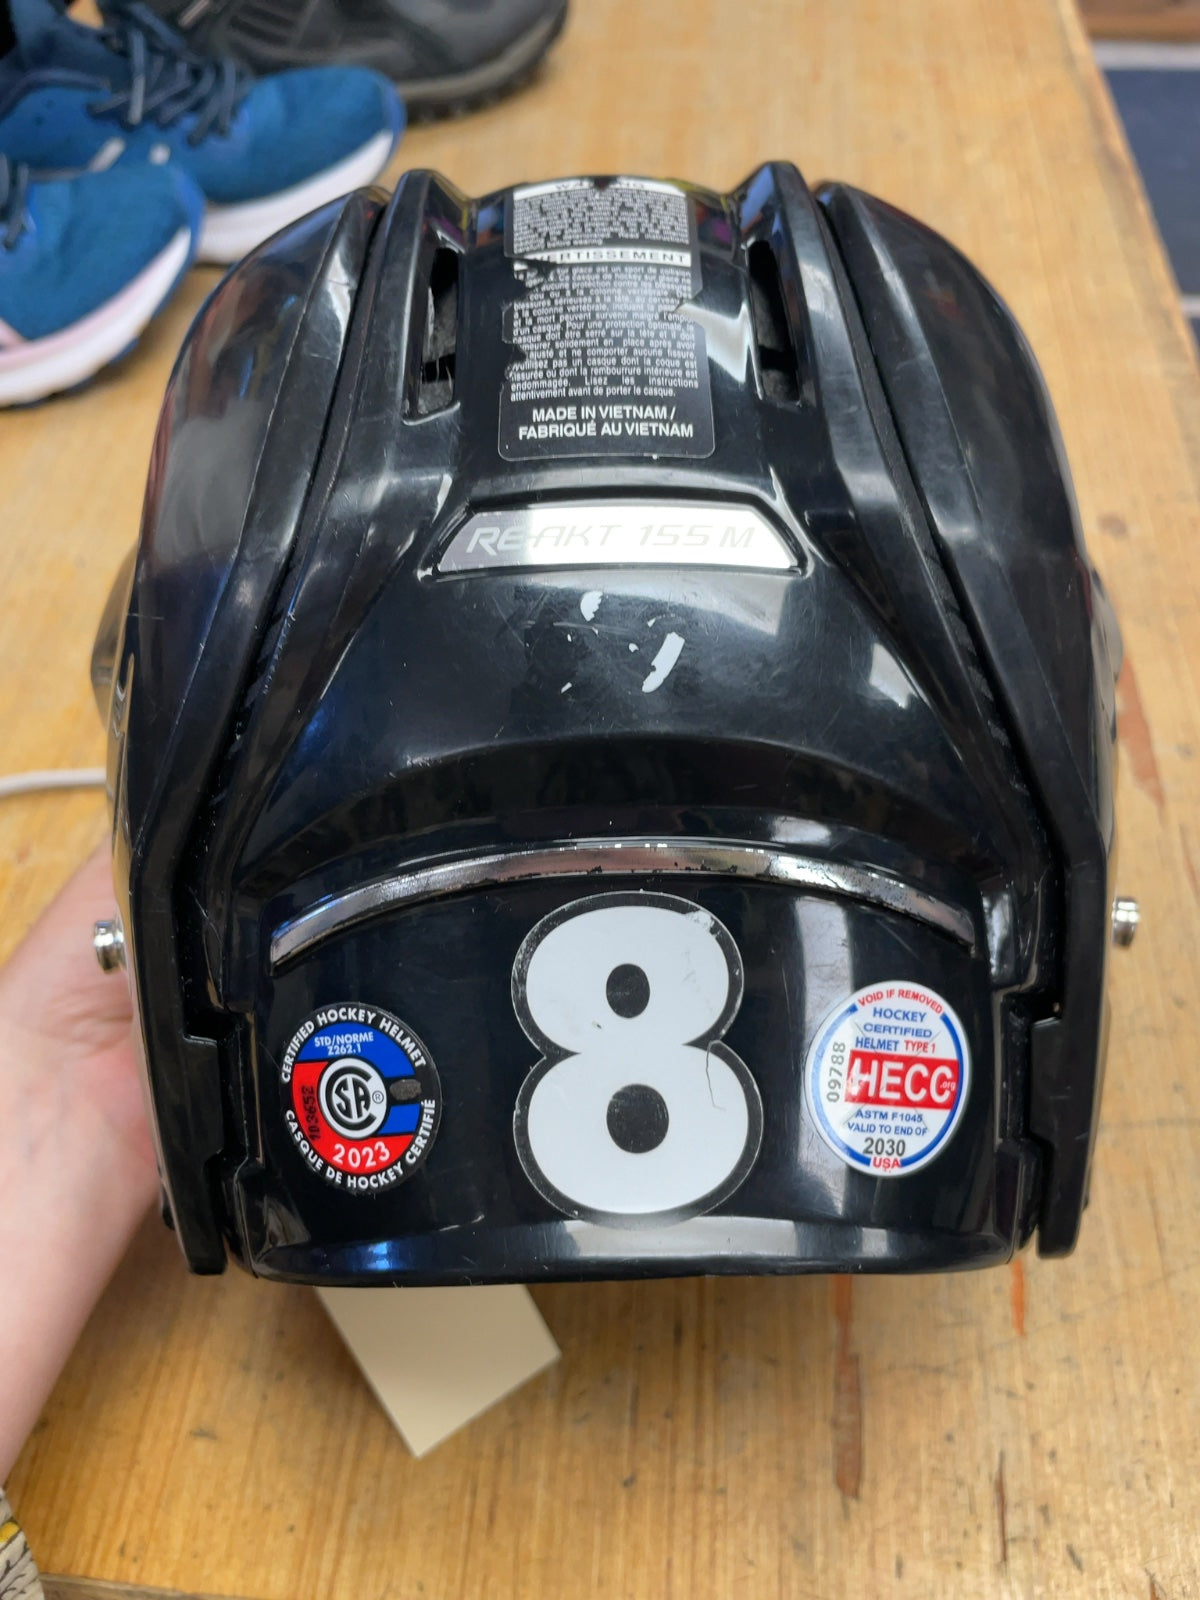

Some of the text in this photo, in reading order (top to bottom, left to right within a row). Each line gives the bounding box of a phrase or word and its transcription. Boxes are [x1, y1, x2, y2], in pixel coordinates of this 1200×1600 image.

[533, 250, 686, 263] ERTISSEMENT
[533, 303, 564, 317] colonne
[513, 317, 521, 328] et
[525, 316, 533, 326] la
[537, 312, 555, 324] mort
[560, 311, 592, 323] peuvent
[595, 309, 628, 320] survenir
[566, 320, 584, 331] Pour
[587, 319, 603, 330] une
[605, 319, 646, 331] protection
[546, 329, 561, 341] doit
[565, 328, 581, 340] être
[585, 327, 606, 339] serré
[610, 328, 623, 338] sur
[627, 327, 635, 338] la
[659, 329, 667, 339] et
[555, 338, 599, 350] solidement
[603, 337, 614, 347] en
[622, 336, 645, 349] place
[649, 337, 672, 349] après
[676, 338, 696, 350] avoir
[529, 347, 554, 361] ajusté
[558, 348, 568, 358] et
[571, 348, 582, 358] ne
[586, 346, 628, 358] comporter
[633, 347, 663, 357] aucune
[552, 358, 568, 371] pas
[572, 357, 582, 367] un
[586, 356, 617, 368] casque
[621, 355, 639, 366] dont
[643, 355, 651, 366] la
[655, 357, 681, 369] coque
[684, 357, 697, 369] est
[546, 367, 557, 379] ou
[559, 366, 578, 377] dont
[580, 365, 588, 377] la
[590, 364, 642, 377] rembourrure
[643, 364, 683, 376] intérieure
[685, 366, 698, 379] est
[511, 375, 699, 392] endommagée. Lisez les instructions
[511, 384, 676, 402] attentivement avant de porter le casque.
[532, 405, 676, 423] MADE IN VIETNAM /
[518, 420, 694, 440] FABRIQUÉ AU VIETNAM
[858, 989, 943, 1014] VOID IF REMOVED
[872, 1007, 927, 1023] HOCKEY
[863, 1022, 932, 1038] CERTIFIED
[281, 1007, 426, 1083] CERTIFIED HOCKEY HELMET
[314, 1032, 374, 1048] STD/NORME
[855, 1037, 936, 1053] HELMET TYPE 1
[327, 1044, 362, 1056] Z262.1
[512, 892, 762, 1226] 8
[827, 1041, 846, 1103] 09788
[851, 1057, 953, 1103] HECC
[855, 1109, 888, 1120] ASTM
[847, 1121, 928, 1137] VALID TO END OF
[284, 1099, 435, 1190] CASQUE DE HOCKEY CERTIFIÉ
[863, 1136, 906, 1156] 2030
[332, 1141, 390, 1168] 2023
[872, 1156, 901, 1169] USA
